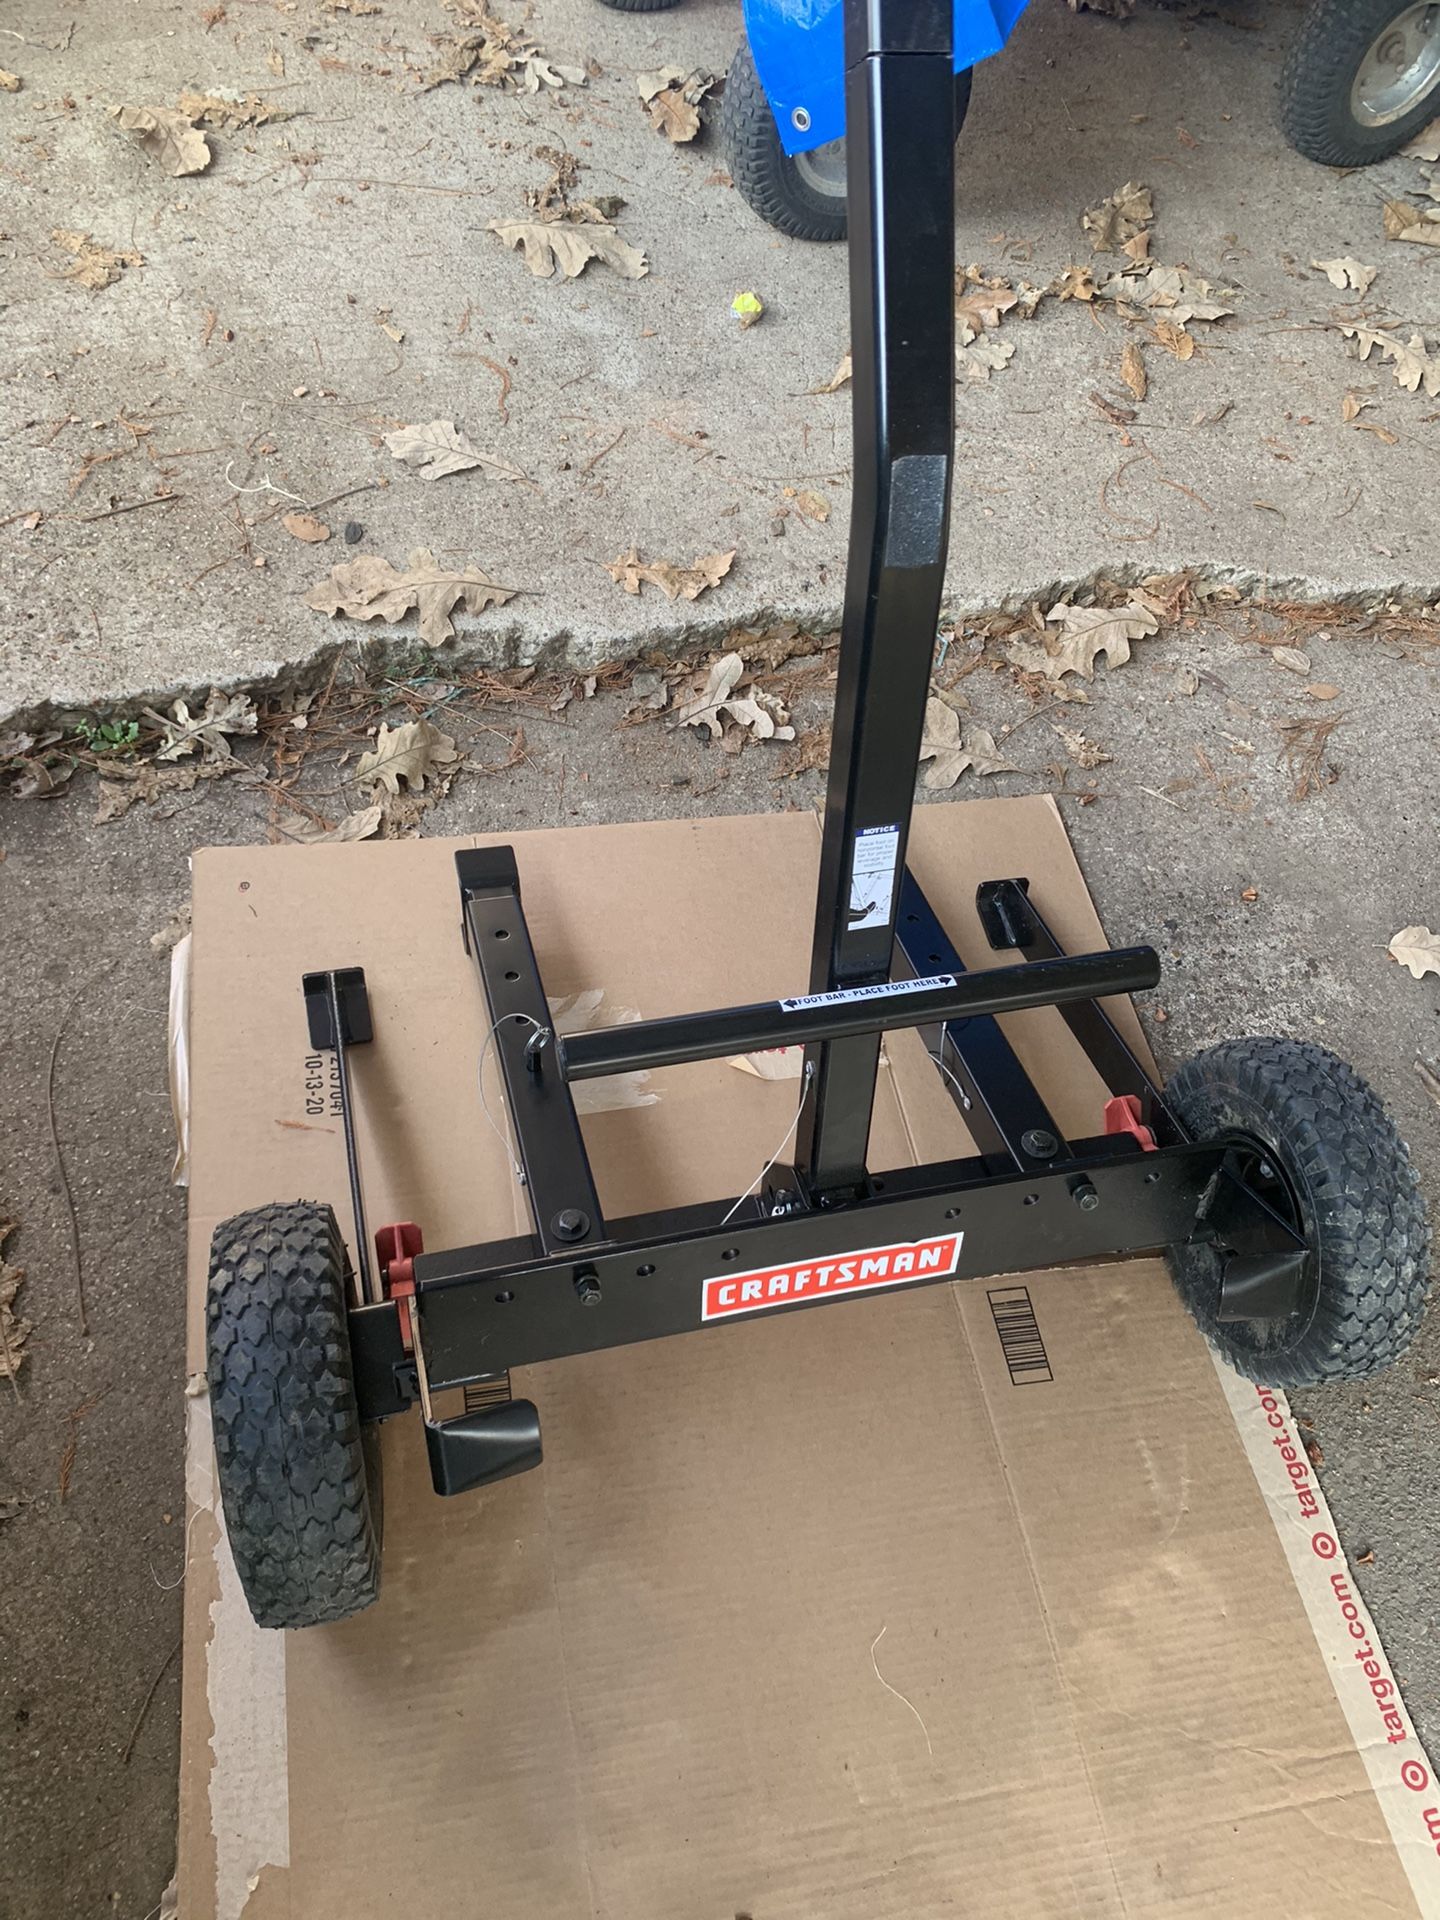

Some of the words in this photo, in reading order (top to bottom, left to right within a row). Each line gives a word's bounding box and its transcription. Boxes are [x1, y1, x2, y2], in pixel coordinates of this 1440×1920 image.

[863, 825, 896, 835] NOTICE
[796, 995, 823, 1005] FOOT
[826, 992, 846, 1001] BAR
[852, 987, 884, 998] PLACE
[885, 982, 910, 992] FOOT
[913, 978, 939, 988] HERE
[305, 1053, 324, 1115] 10-13-20
[718, 1246, 942, 1306] CRAFTSMAN
[1330, 1573, 1407, 1745] target.com
